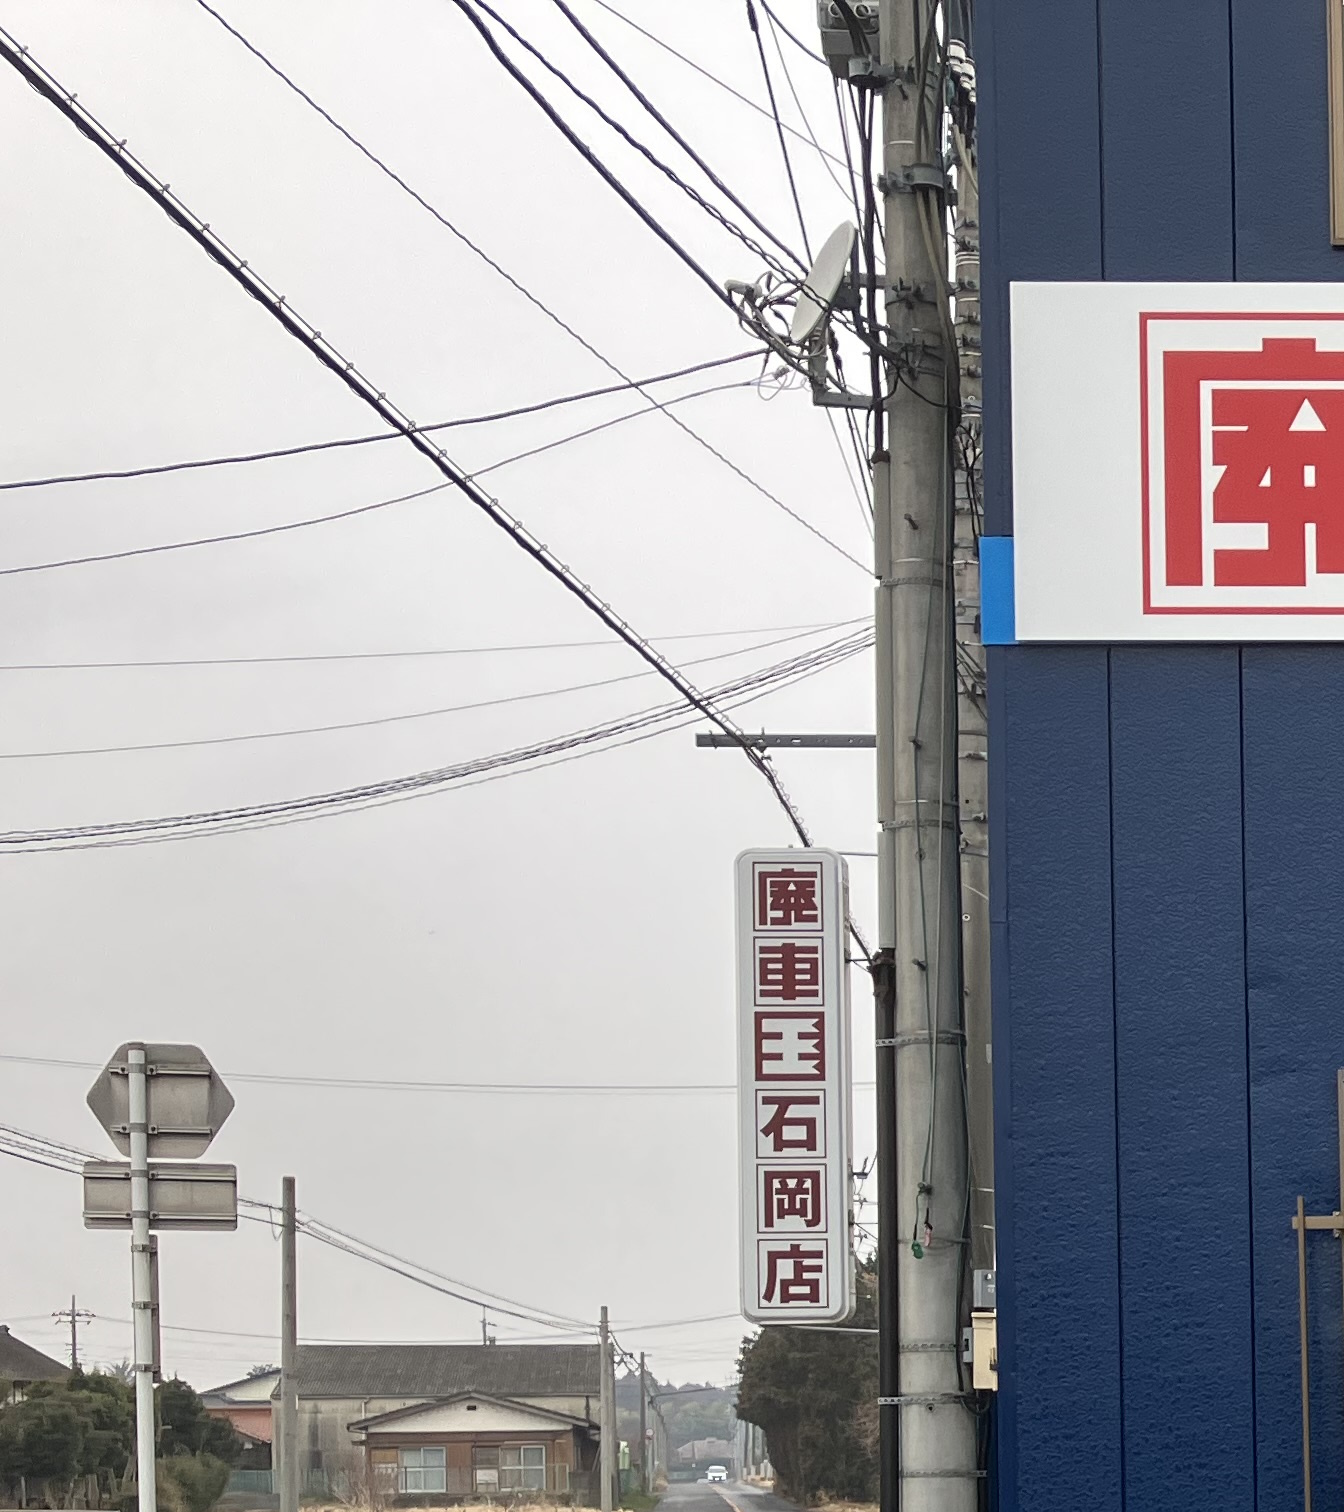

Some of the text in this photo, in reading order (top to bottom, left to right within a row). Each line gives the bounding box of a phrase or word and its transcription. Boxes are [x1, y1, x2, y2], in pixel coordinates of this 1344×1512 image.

[757, 868, 825, 1305] 廃車王石岡店
